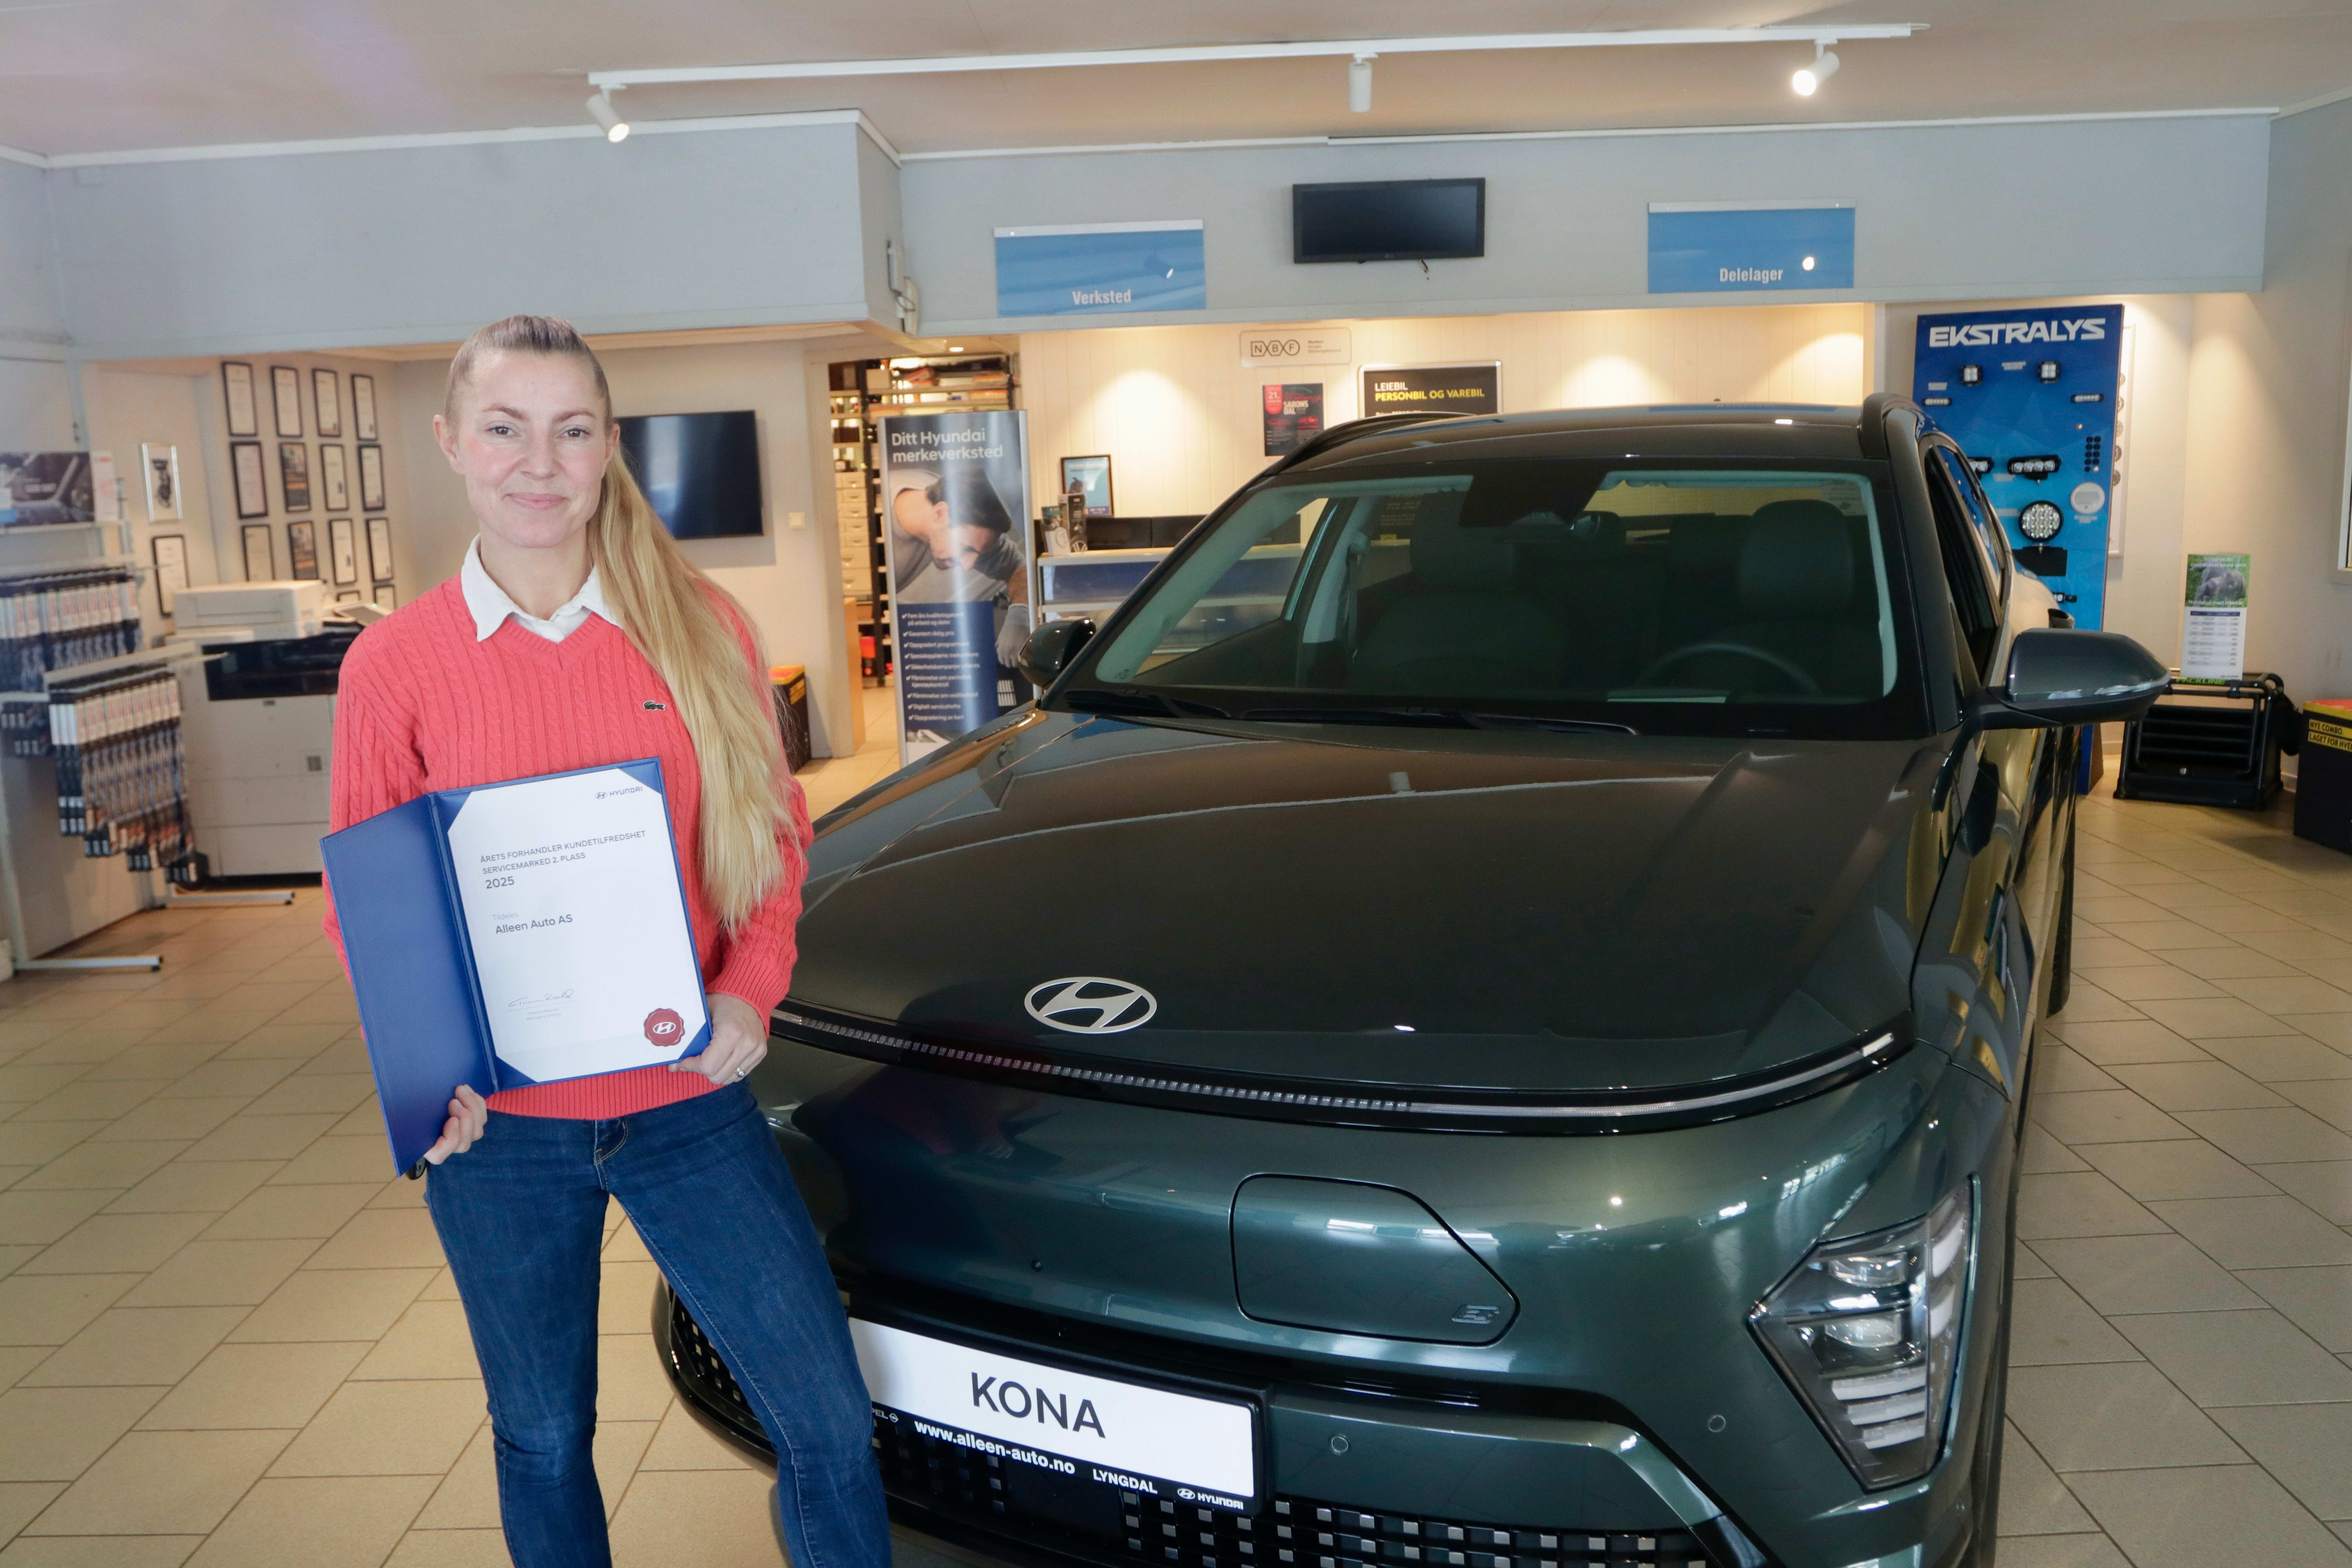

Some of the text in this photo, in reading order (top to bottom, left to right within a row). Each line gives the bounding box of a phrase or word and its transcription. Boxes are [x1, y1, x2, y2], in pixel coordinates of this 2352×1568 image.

[1719, 267, 1784, 284] Delelager
[1072, 289, 1132, 305] Verksted
[1929, 318, 2106, 348] EKSTRALYS
[1374, 381, 1408, 392] LEIEBIL
[1375, 388, 1485, 402] PERSONBIL OG VAREBIL
[891, 428, 986, 446] Ditt Hyundai
[892, 445, 1004, 463] merkeverksted
[2310, 721, 2321, 730] NYE
[2309, 733, 2327, 743] LAGET
[2327, 737, 2338, 747] FOR
[609, 786, 643, 797] HYUNDAI
[480, 830, 646, 863] ÅRETS FORHANDLER KUNDETILFREDSHET
[482, 858, 551, 874] SERVICEMARKED
[560, 852, 586, 862] PLASS
[485, 876, 515, 889] 2025
[492, 912, 519, 921] Tildeles
[495, 914, 573, 934] Alleen Auto AS
[971, 1372, 1106, 1439] KONA
[914, 1421, 1076, 1474] www.alleen-auto.no
[1093, 1468, 1158, 1494] LYNGDAL
[1197, 1492, 1244, 1510] HYUNDAI
